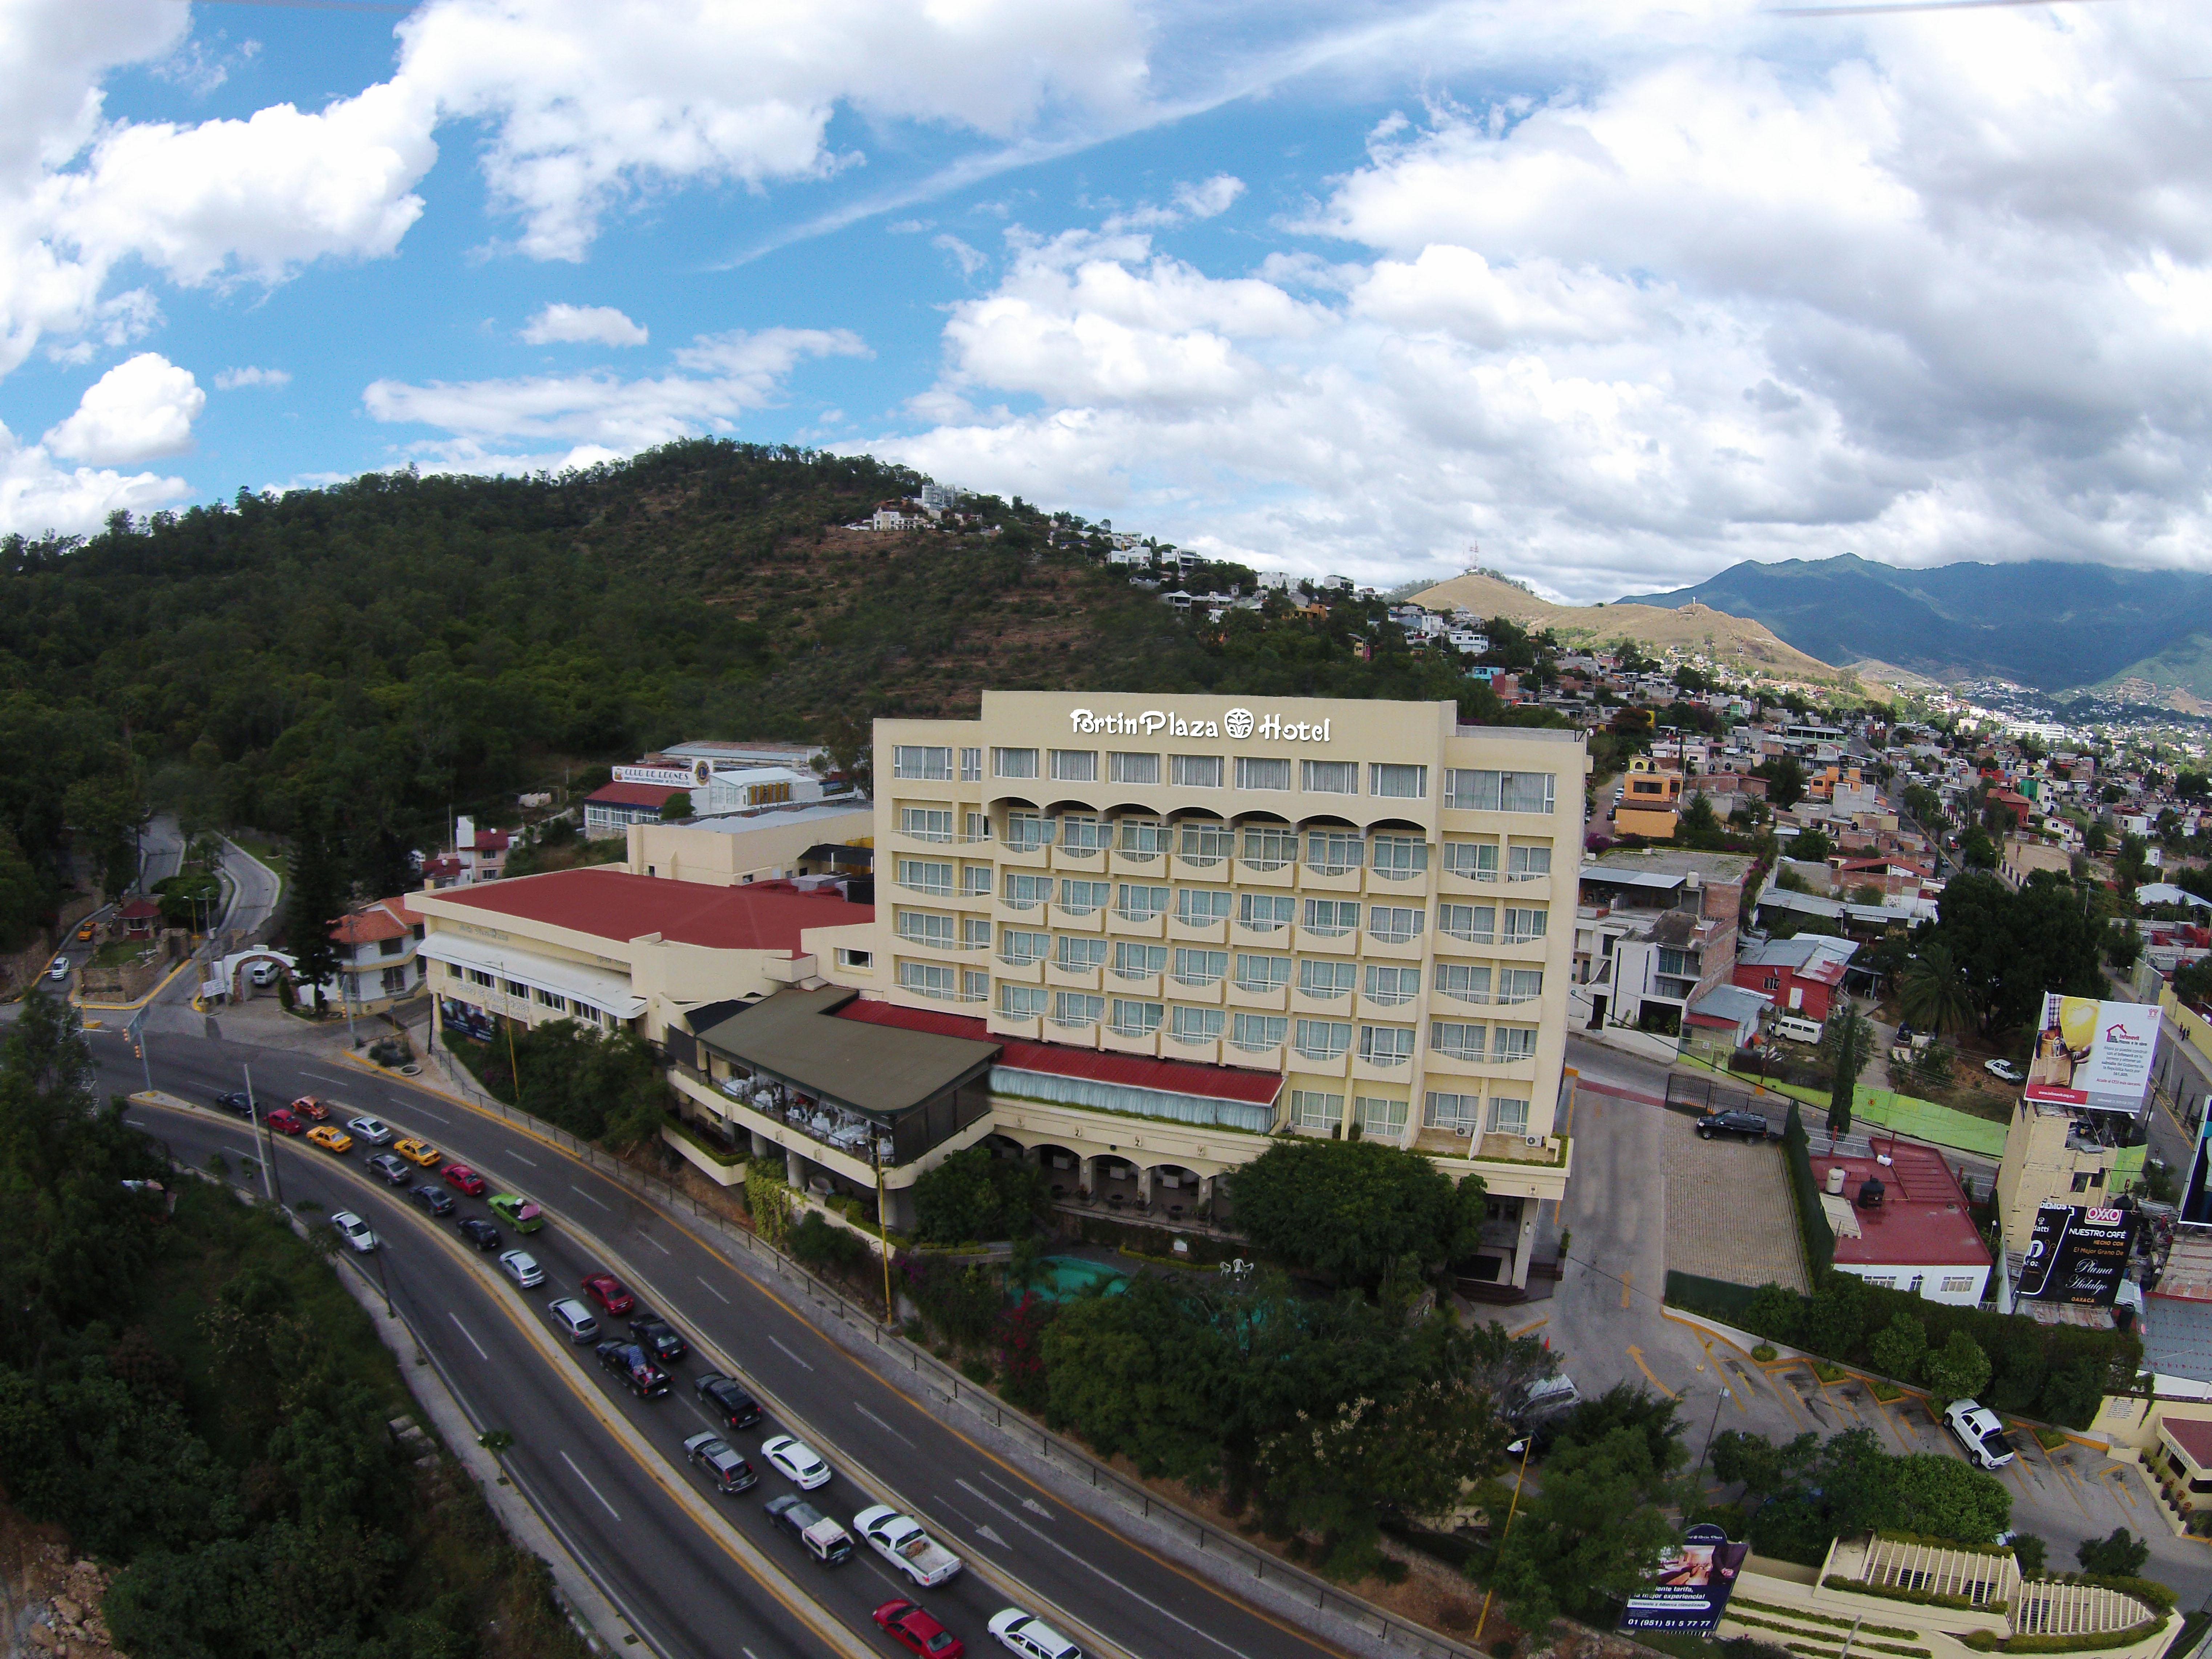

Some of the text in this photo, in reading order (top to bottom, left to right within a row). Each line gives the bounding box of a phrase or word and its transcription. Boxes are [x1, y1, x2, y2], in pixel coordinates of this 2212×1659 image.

[1070, 709, 1330, 741] Fortin Plaza Hotel
[2088, 1208, 2119, 1221] OXXO
[2069, 1228, 2127, 1239] NUESTRO CAFÉ
[2075, 1258, 2113, 1274] Pluma
[2065, 1274, 2107, 1295] Hidalgo
